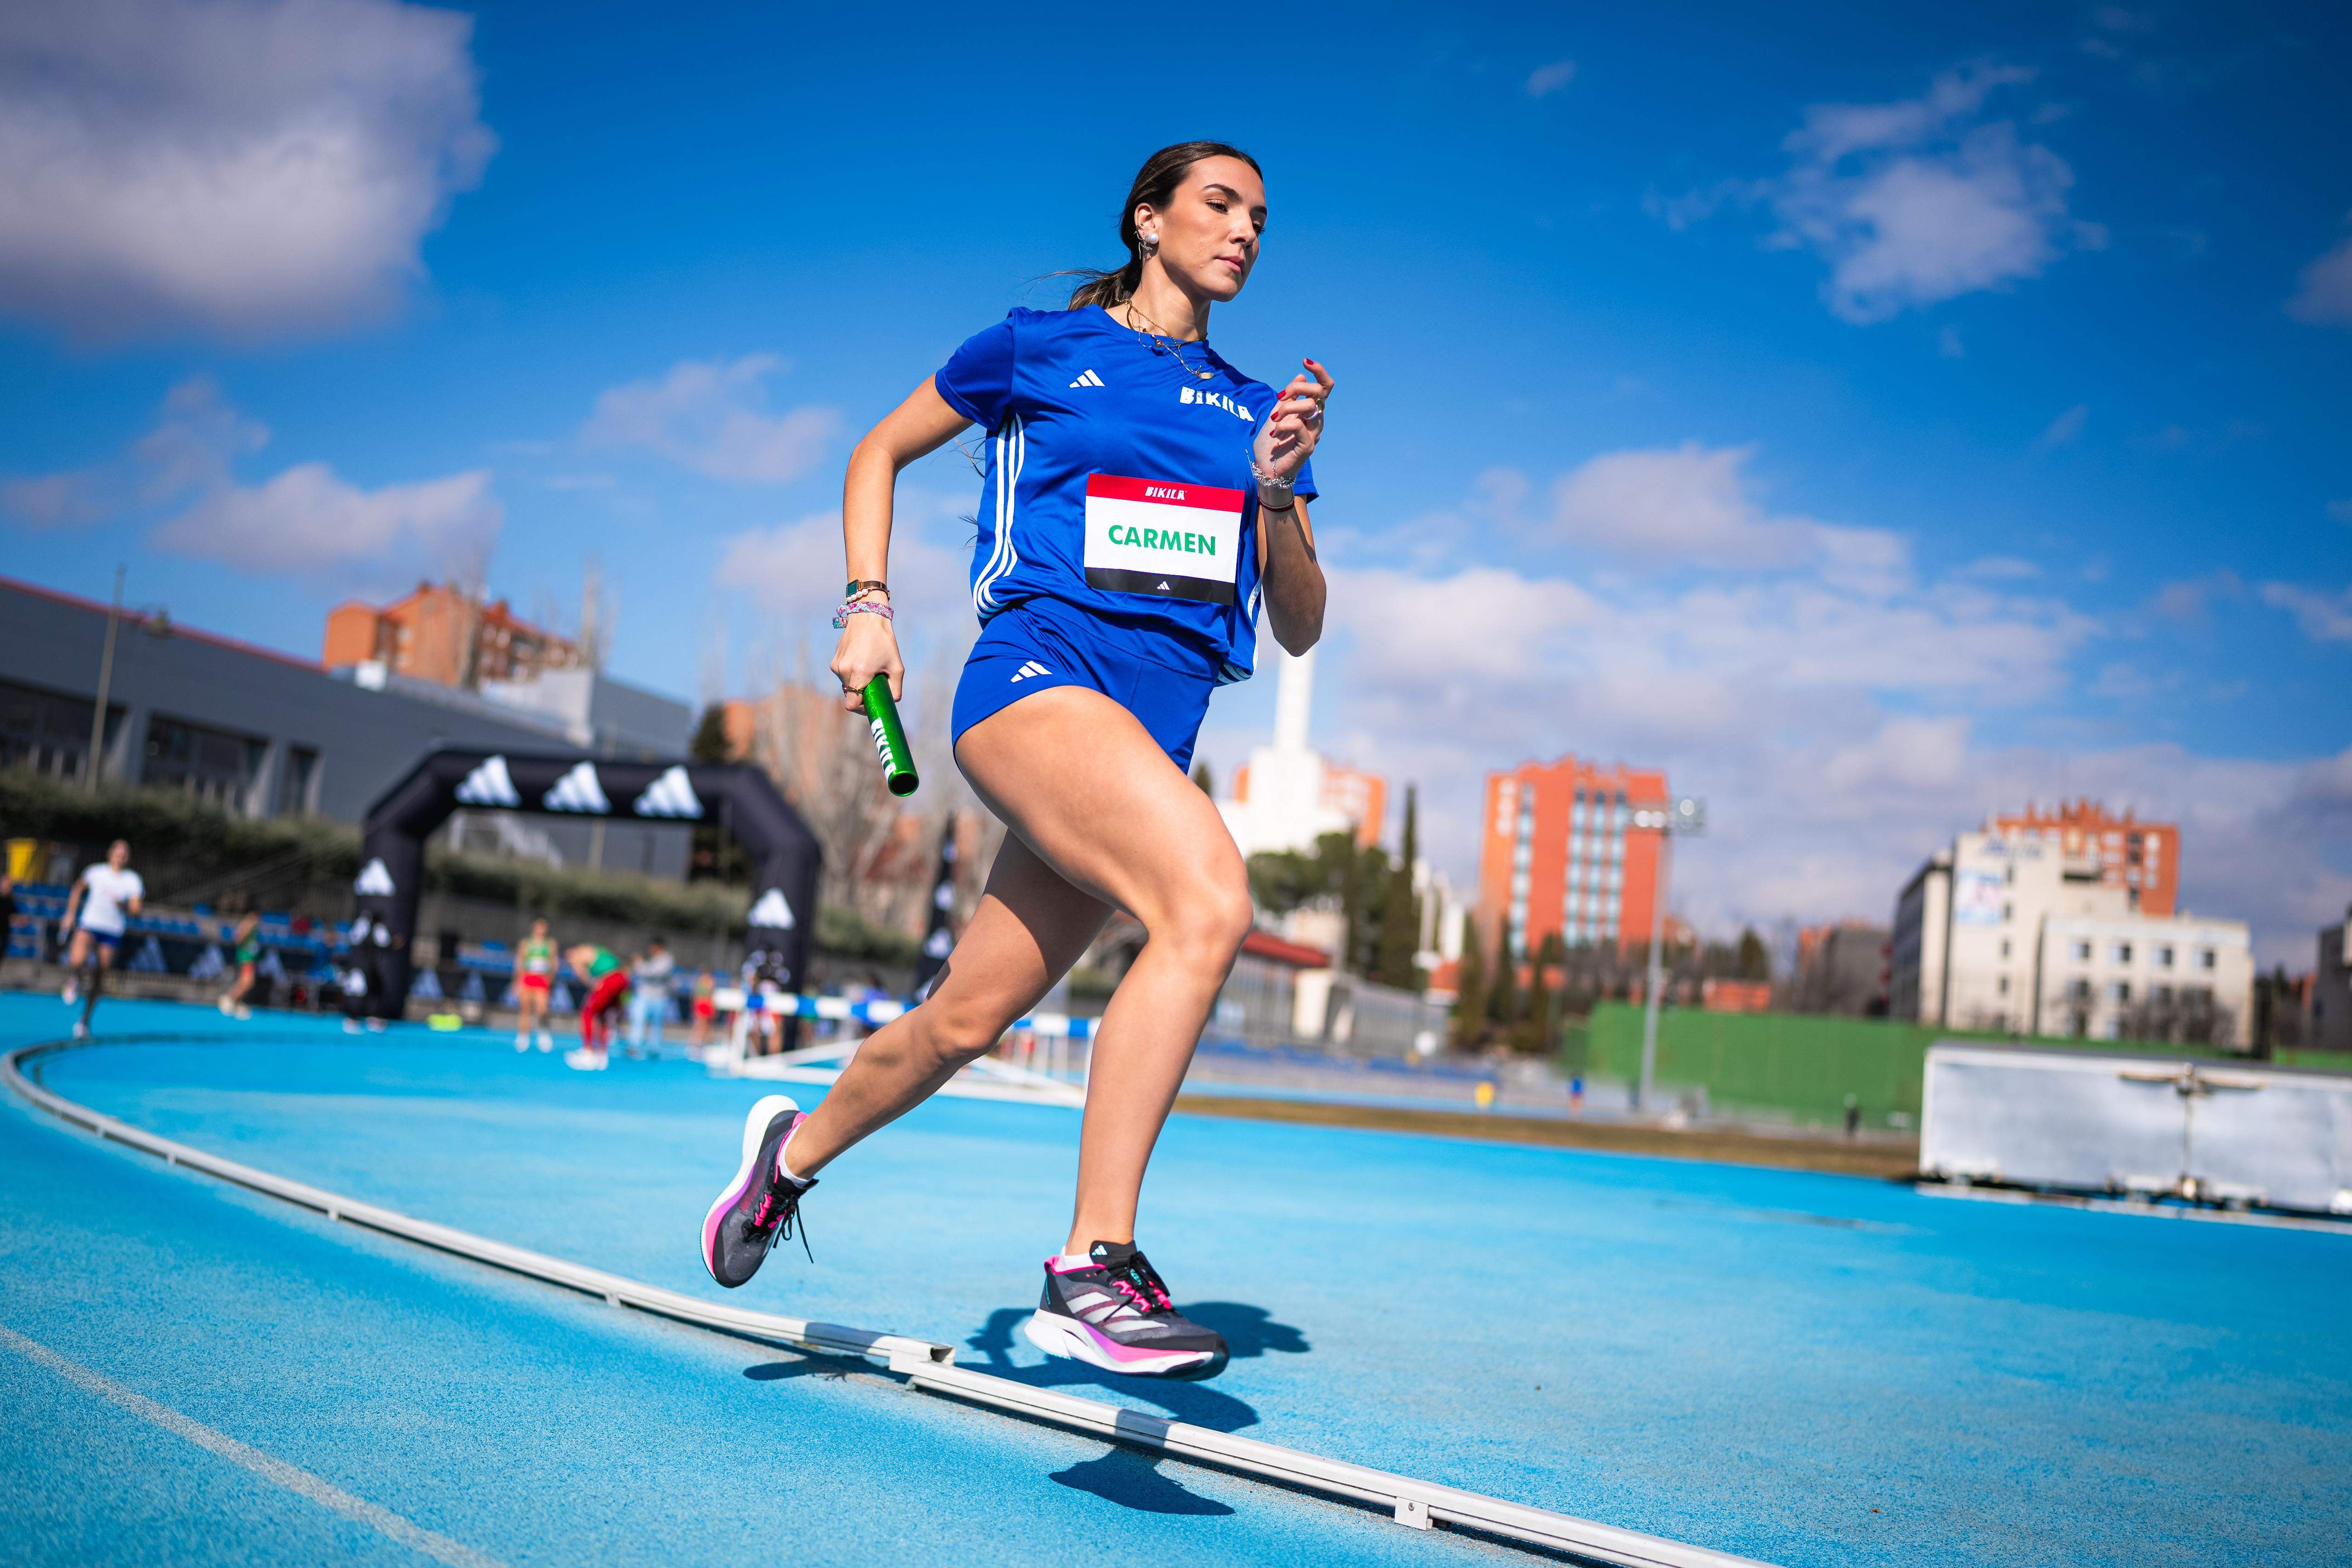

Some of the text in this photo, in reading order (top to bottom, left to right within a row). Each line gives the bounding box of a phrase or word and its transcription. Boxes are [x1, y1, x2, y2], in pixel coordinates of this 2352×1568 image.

[1180, 386, 1255, 421] BIKILA
[1145, 486, 1185, 500] BIKILA
[1108, 525, 1216, 555] CARMEN
